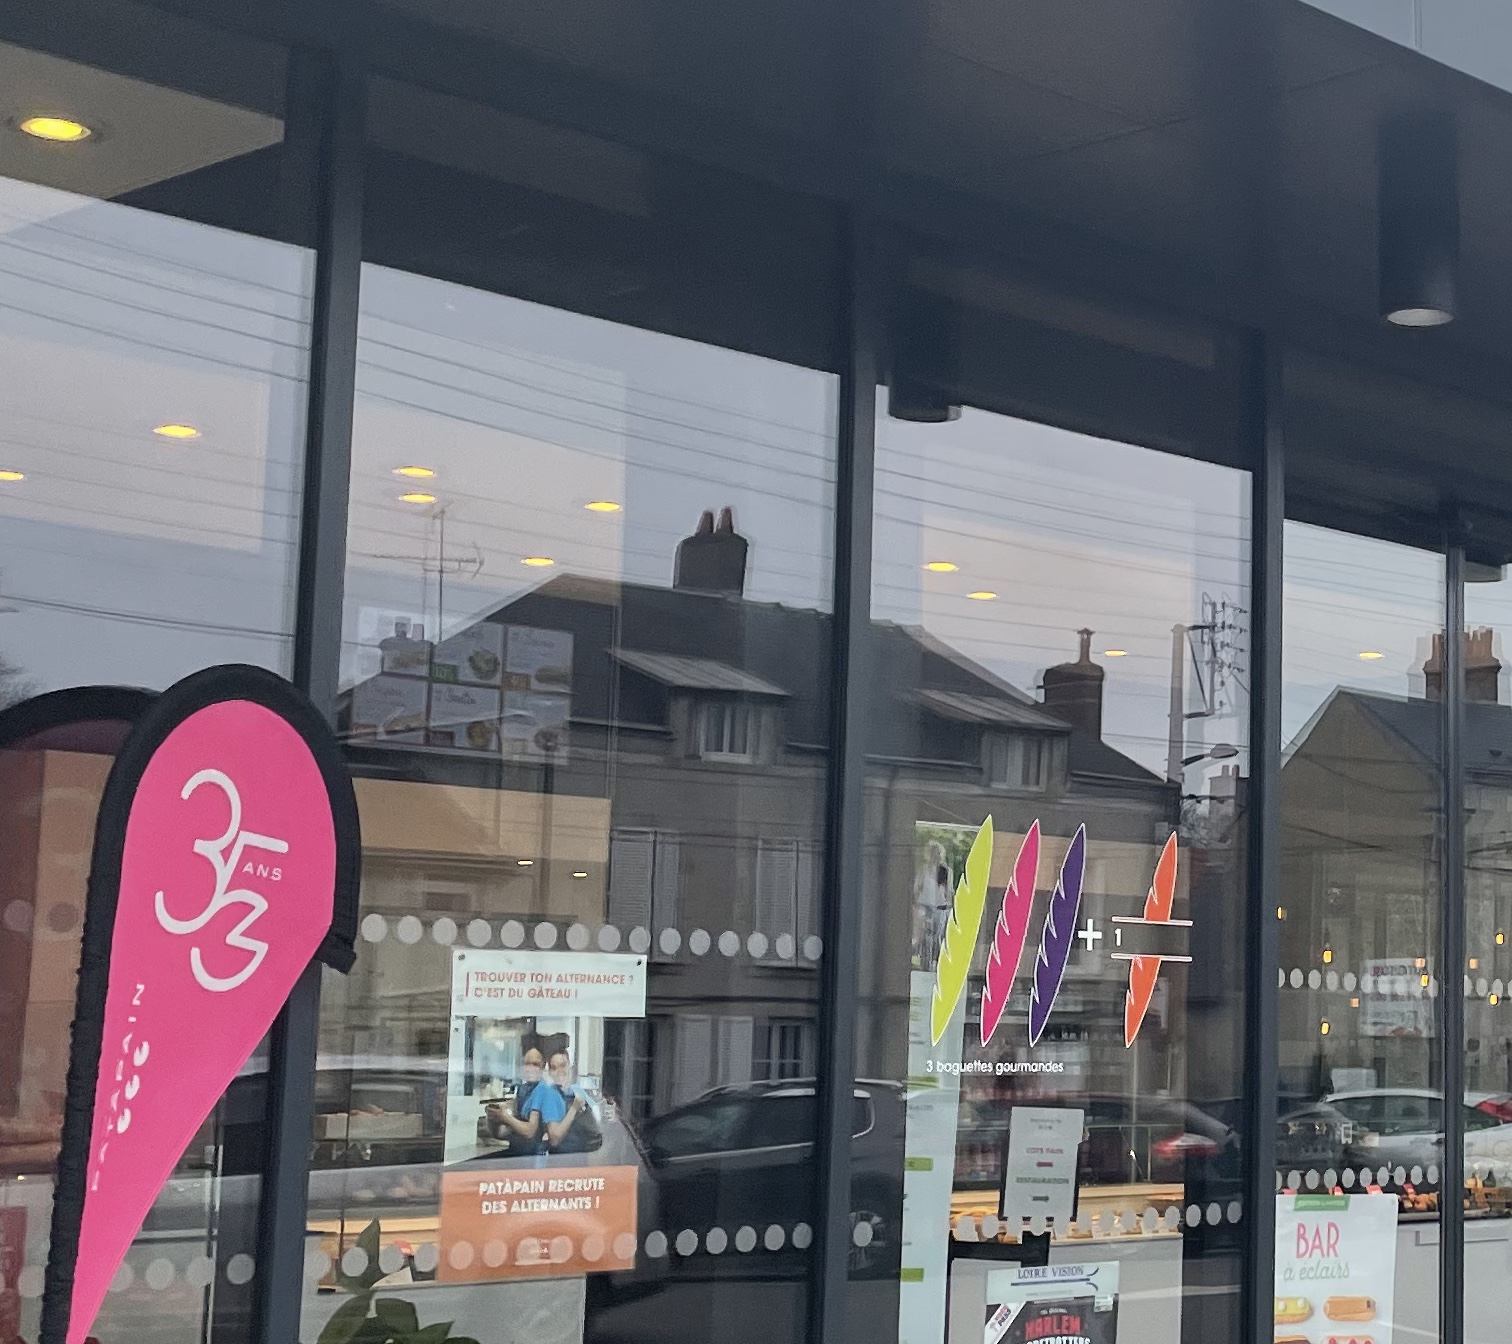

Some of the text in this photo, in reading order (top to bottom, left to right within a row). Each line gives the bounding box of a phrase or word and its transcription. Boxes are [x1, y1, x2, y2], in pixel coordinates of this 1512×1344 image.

[242, 861, 283, 882] ANS
[1115, 928, 1122, 946] 1
[474, 971, 526, 983] TROUVER
[530, 972, 551, 983] TON
[555, 973, 625, 985] ALTERNANCE
[508, 987, 524, 999] DU
[926, 1060, 1064, 1076] 3 baguettes gourmandes
[548, 1177, 605, 1193] RECRUTE
[482, 1201, 507, 1214] DES
[511, 1197, 592, 1213] ALTERNANTS
[1296, 1221, 1340, 1259] BAR
[1017, 1266, 1084, 1280] LOIRE VISION
[1300, 1260, 1350, 1280] éclairs
[1025, 1314, 1081, 1340] HARLEM
